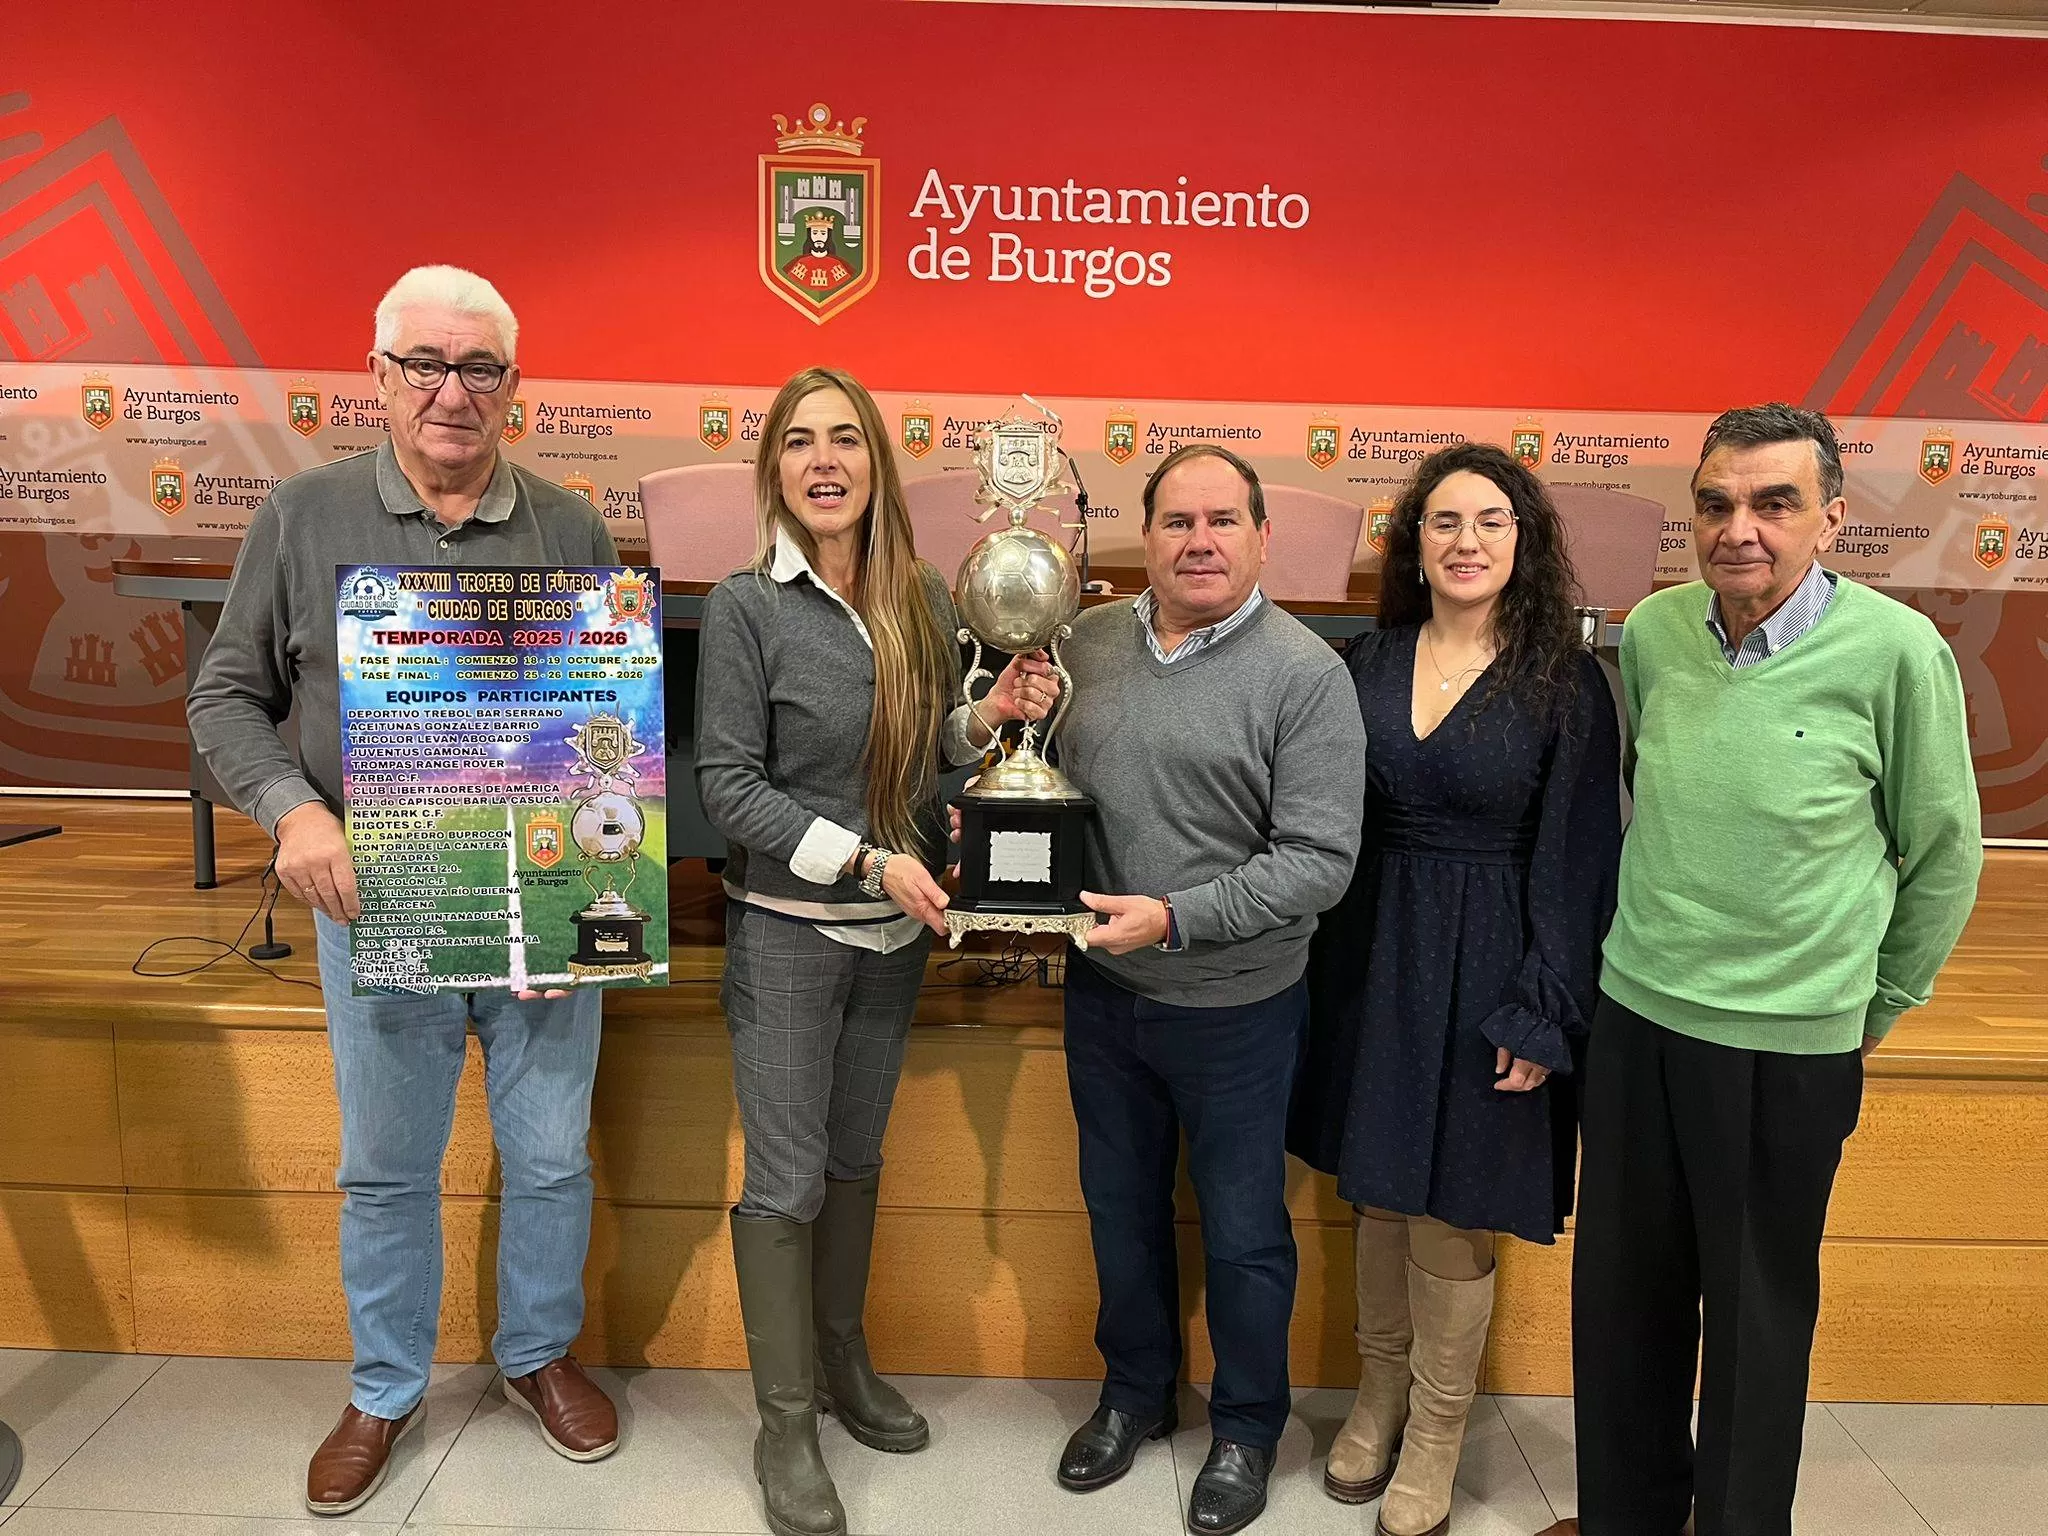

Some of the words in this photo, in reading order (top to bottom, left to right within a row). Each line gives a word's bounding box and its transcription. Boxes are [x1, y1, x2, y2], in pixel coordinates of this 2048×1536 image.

[908, 169, 1310, 235] Ayuntamiento
[907, 227, 970, 281] de
[987, 232, 1172, 299] Burgos
[123, 387, 239, 408] Ayuntamiento
[123, 404, 142, 420] de
[147, 405, 201, 425] Burgos
[536, 402, 652, 420] Ayuntamiento
[331, 411, 350, 428] de
[354, 413, 391, 432] Burg
[536, 419, 555, 434] de
[559, 421, 613, 439] Burgos
[740, 425, 760, 441] de
[1146, 422, 1262, 441] Ayuntamiento
[126, 437, 207, 446] www.aytoburgos.es
[942, 433, 961, 449] de
[1349, 427, 1466, 446] Ayuntamiento
[1553, 431, 1670, 450] Ayuntamiento
[1145, 439, 1164, 455] de
[1963, 443, 2048, 461] Ayuntamie
[537, 451, 618, 461] www.aytoburgos.es
[1347, 444, 1366, 459] de
[1371, 445, 1425, 464] Burgos
[1551, 449, 1570, 464] de
[1574, 450, 1629, 468] Burgos
[1960, 459, 1979, 475] de
[1983, 461, 2036, 480] Burgos
[17, 485, 70, 504] Burgos
[194, 489, 213, 504] de
[218, 491, 266, 510] Burgo
[1958, 491, 2037, 502] www.aytoburgos.es
[603, 504, 622, 519] de
[1835, 539, 1889, 558] Burgos
[2015, 544, 2034, 559] de
[398, 573, 451, 592] XXXVIII
[457, 573, 514, 592] TROFEO
[521, 573, 541, 593] DE
[547, 569, 601, 593] FÚTBOL
[428, 600, 481, 620] CIUDAD
[488, 600, 508, 620] DE
[514, 600, 574, 621] BURGOS
[372, 631, 504, 646] TEMPORADA
[514, 630, 562, 646] 2025
[579, 630, 629, 646] 2026
[360, 656, 390, 665] FASE
[456, 655, 518, 665] COMIENZO
[524, 656, 537, 665] 18
[548, 656, 561, 665] 19
[567, 655, 621, 665] OCTUBRE
[631, 655, 658, 664] 2025
[361, 671, 391, 680] FASE
[456, 671, 518, 680] COMIENZO
[524, 671, 538, 679] 25
[548, 671, 561, 679] 26
[568, 670, 606, 679] ENERO
[617, 670, 643, 679] 2026
[386, 690, 467, 705] EQUIPOS
[478, 689, 617, 703] PARTICIPANTES
[348, 710, 420, 719] DEPORTIVO
[476, 709, 501, 718] BAR
[505, 708, 563, 718] SERRANO
[350, 722, 421, 732] ACEITUNAS
[494, 721, 540, 731] BARRIO
[350, 735, 414, 744] TRICOLOR
[418, 735, 458, 744] LEVAN
[462, 734, 531, 744] ABOGADOS
[350, 748, 420, 757] JUVENTUS
[424, 747, 487, 757] GAMONAL
[351, 761, 412, 770] TROMPAS
[416, 760, 459, 769] RANGE
[463, 759, 506, 769] ROVER
[352, 773, 393, 783] FARBA
[397, 773, 420, 783] C.F.
[353, 786, 386, 796] CLUB
[390, 785, 482, 795] LIBERTADORES
[485, 785, 501, 794] DE
[505, 783, 560, 794] AMÉRICA
[351, 798, 377, 808] R.U.
[398, 797, 460, 807] CAPISCOL
[463, 796, 488, 806] BAR
[491, 797, 508, 806] LA
[510, 796, 561, 805] CASUCA
[352, 810, 381, 820] NEW
[385, 809, 418, 819] PARK
[422, 809, 444, 819] C.F.
[352, 821, 410, 831] BIGOTES
[413, 820, 436, 830] C.F.
[352, 833, 375, 842] C.D.
[379, 832, 403, 841] SAN
[406, 831, 445, 841] PEDRO
[448, 830, 512, 840] BUPROCON
[353, 843, 415, 853] HONTORIA
[418, 842, 433, 852] DE
[436, 842, 451, 851] LA
[454, 841, 509, 851] CANTERA
[352, 855, 375, 864] C.D.
[379, 853, 439, 863] TALADRAS
[353, 866, 404, 875] VIRUTAS
[407, 865, 437, 874] TAKE
[440, 865, 462, 874] 2.0.
[512, 869, 582, 880] Ayuntamiento
[387, 875, 425, 886] COLÓN
[427, 876, 448, 886] C.F.
[524, 878, 535, 887] de
[537, 878, 569, 889] Burgos
[379, 888, 448, 898] VILLANUEVA
[472, 887, 522, 896] UBIERNA
[381, 899, 436, 910] BÁRCENA
[414, 910, 521, 922] QUINTANADUEÑAS
[355, 927, 424, 937] VILLATORO
[426, 927, 448, 936] F.C.
[355, 940, 380, 950] C.D.
[383, 940, 399, 949] G3
[401, 937, 483, 948] RESTAURANTE
[485, 937, 501, 946] LA
[504, 936, 541, 946] MAFIA
[357, 951, 408, 961] FUDRES
[410, 950, 433, 960] C.F.
[357, 965, 402, 975] BUNIEL
[406, 963, 430, 973] C.F.
[357, 975, 432, 987] SOTRAGERO
[435, 975, 451, 984] LA
[453, 974, 492, 983] RASPA
